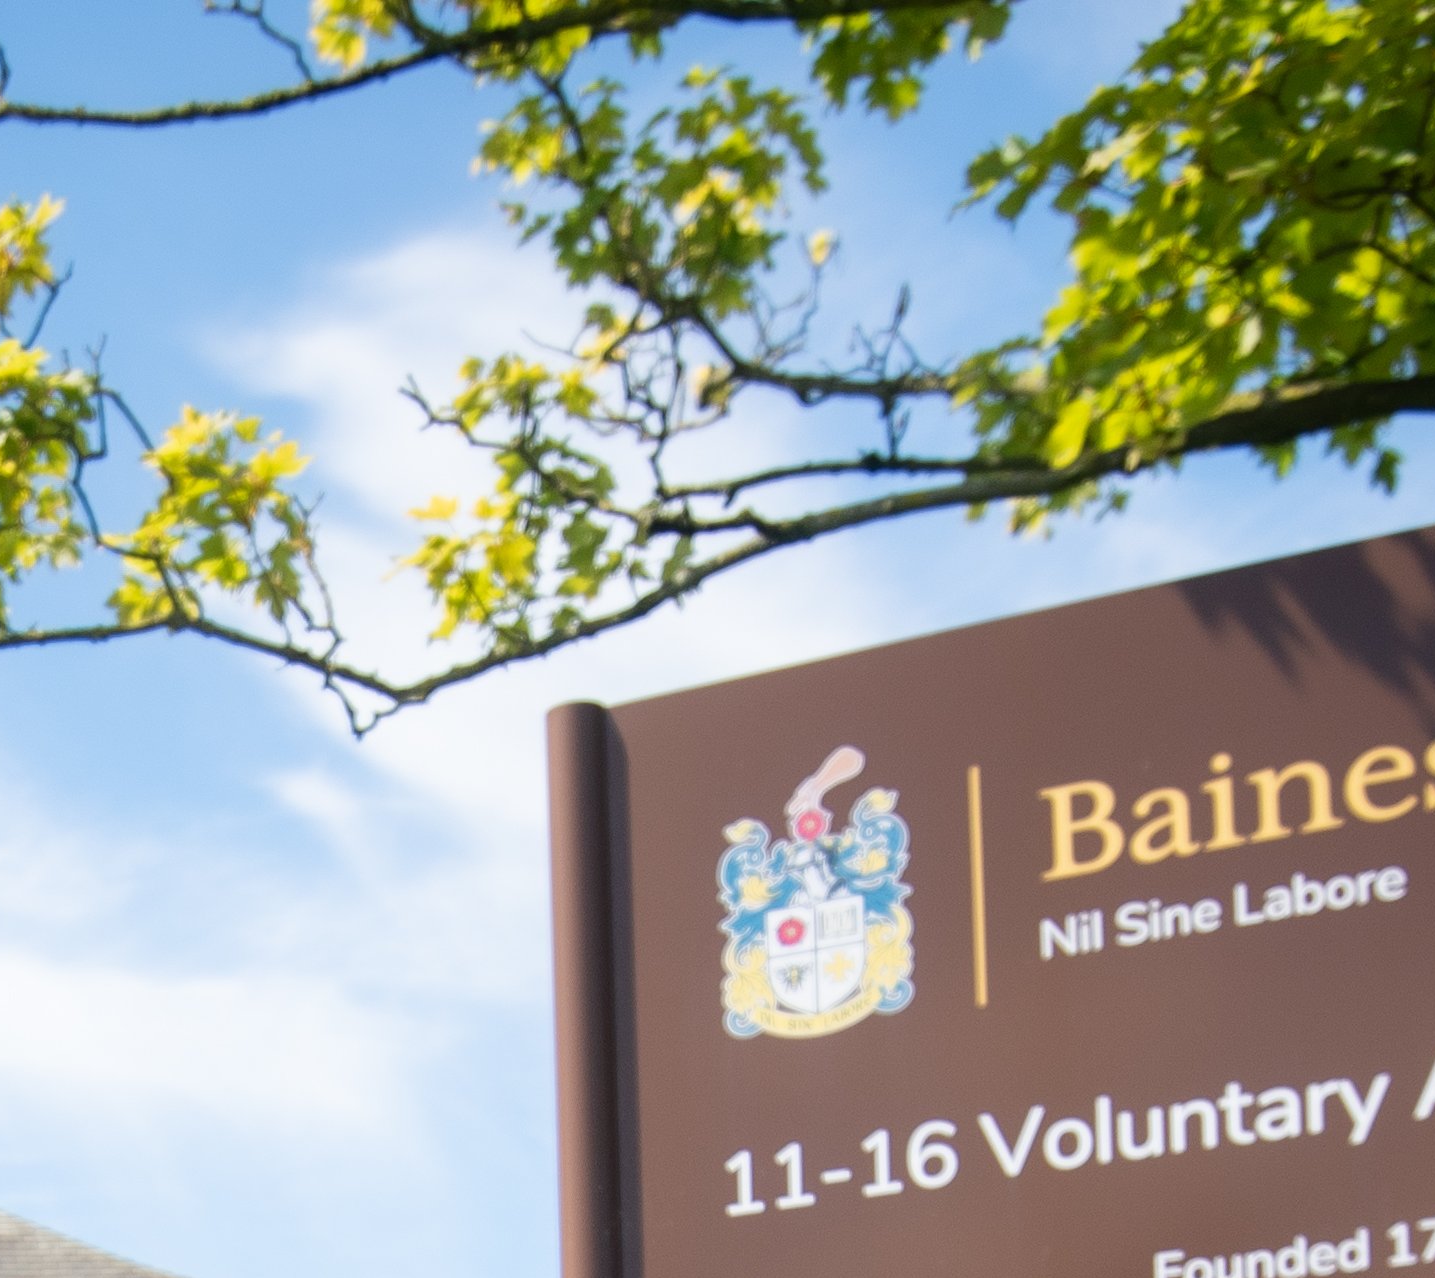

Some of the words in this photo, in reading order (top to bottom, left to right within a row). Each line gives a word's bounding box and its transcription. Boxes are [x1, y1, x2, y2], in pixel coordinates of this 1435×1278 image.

[1038, 909, 1105, 960] Nil
[1113, 898, 1223, 948] Sine
[1232, 866, 1409, 927] Labore
[724, 1119, 960, 1218] 11-16
[977, 1072, 1392, 1178] Voluntary
